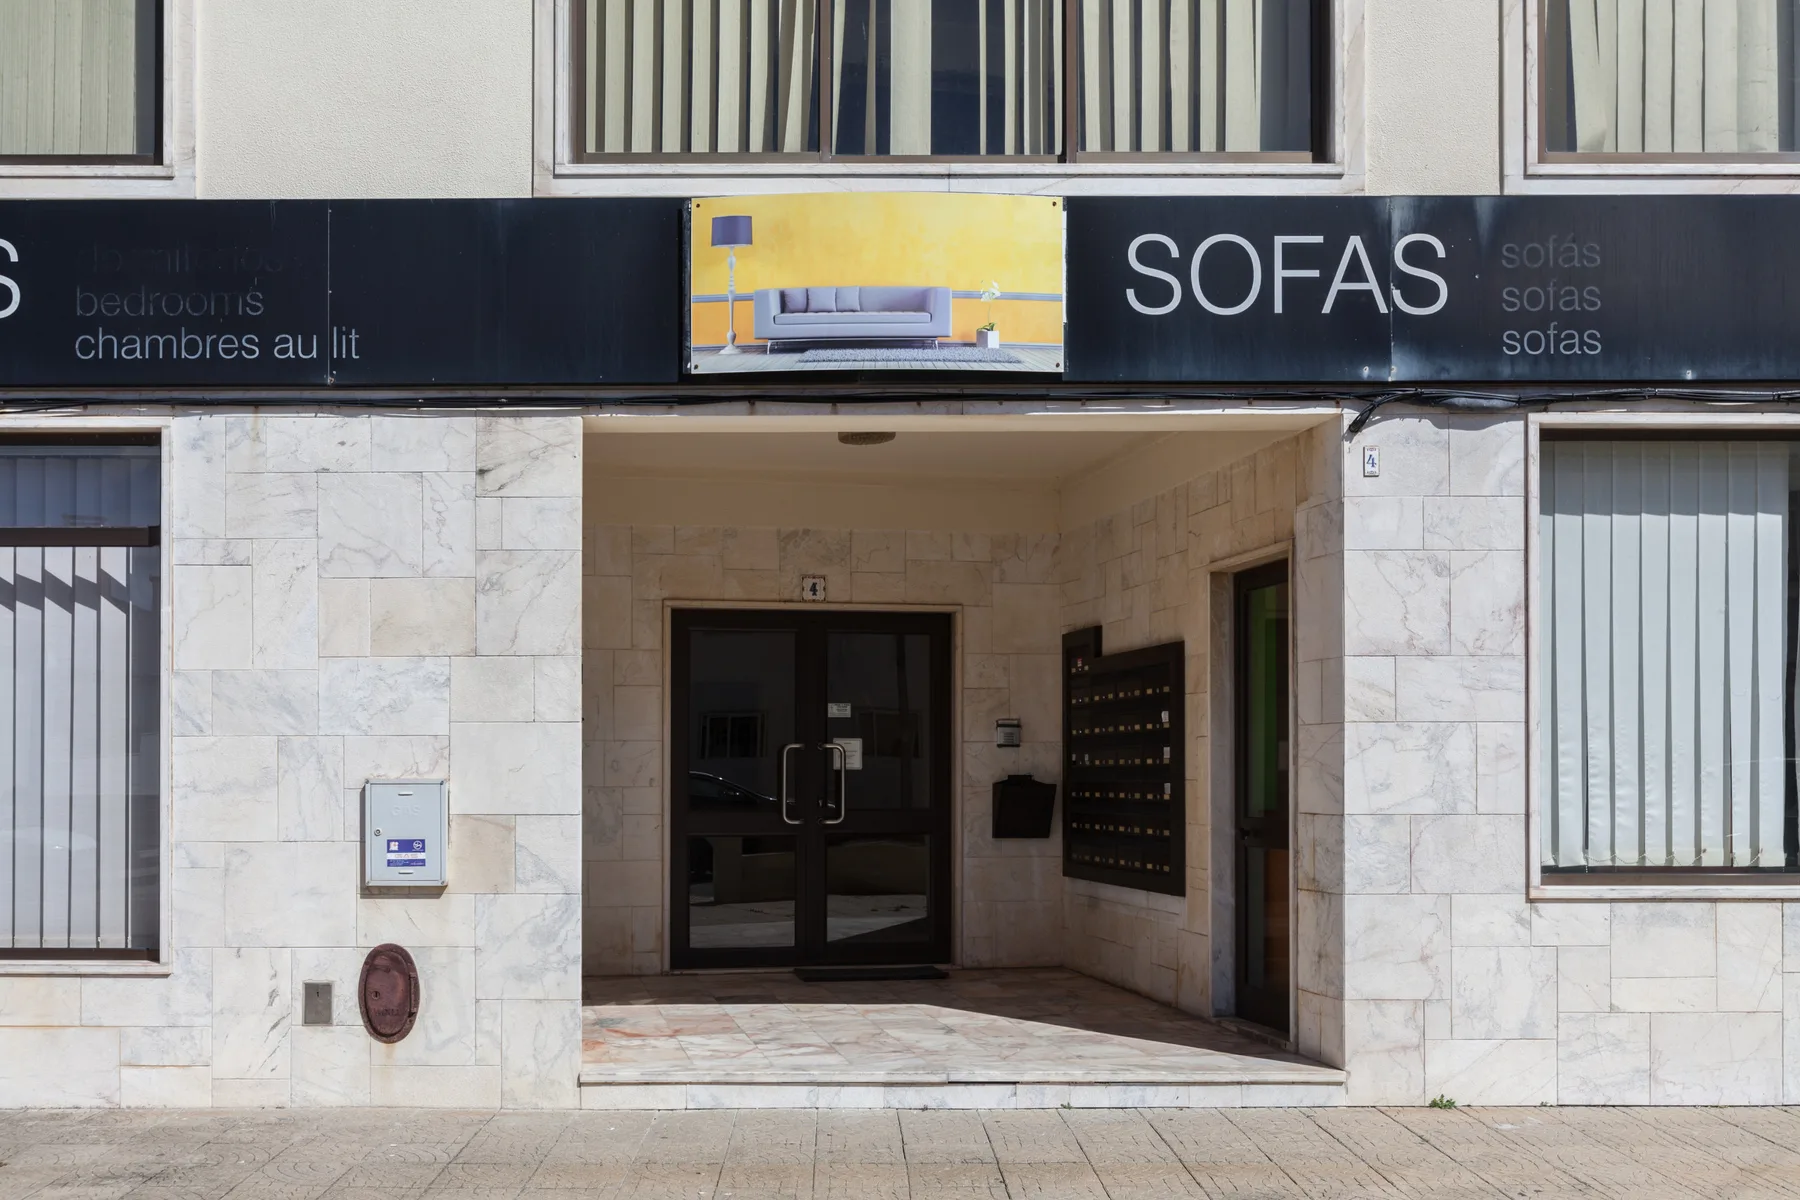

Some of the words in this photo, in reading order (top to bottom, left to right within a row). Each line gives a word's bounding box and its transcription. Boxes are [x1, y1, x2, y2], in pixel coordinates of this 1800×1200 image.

[1501, 232, 1601, 268] sofás
[1125, 233, 1448, 316] SOFAS
[76, 285, 264, 316] bedrooms
[1501, 279, 1602, 312] sofas
[75, 327, 260, 359] chambres
[273, 334, 318, 359] au
[332, 326, 360, 359] lit
[1502, 322, 1602, 355] sofas
[1366, 454, 1377, 468] 4
[809, 582, 818, 597] 4
